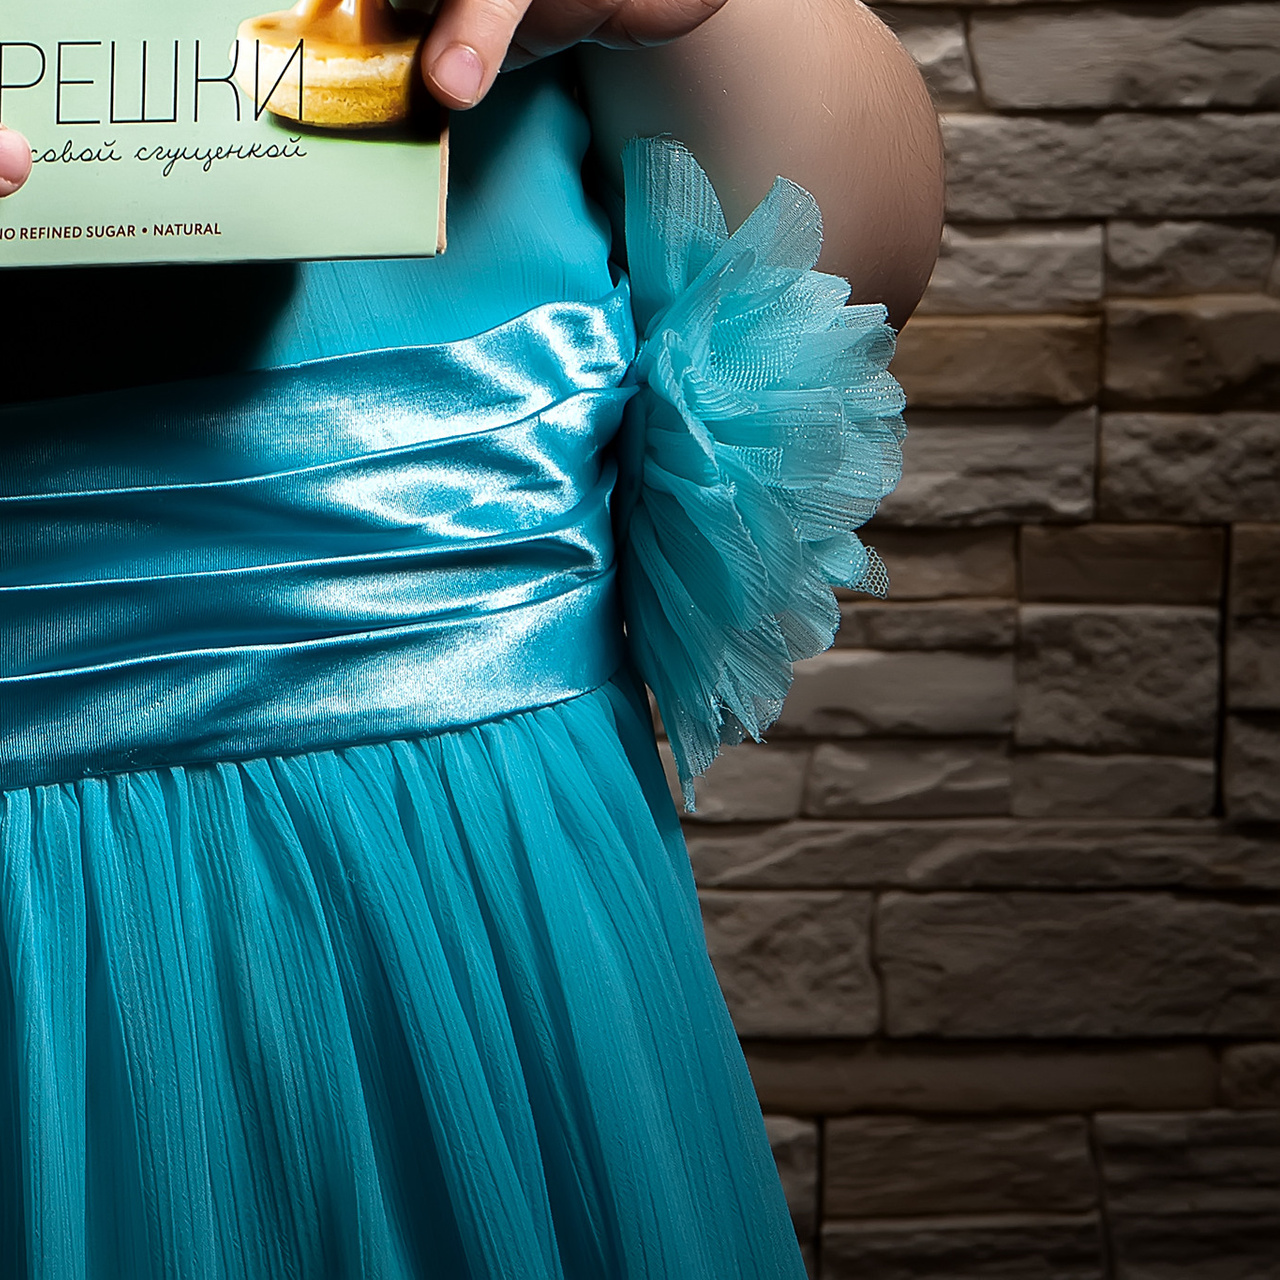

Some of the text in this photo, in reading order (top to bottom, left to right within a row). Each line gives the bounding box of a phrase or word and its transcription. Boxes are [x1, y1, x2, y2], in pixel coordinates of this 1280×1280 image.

[134, 135, 308, 177] сгущенкой
[19, 226, 83, 240] REFINED
[86, 225, 136, 238] SUGAR
[153, 222, 222, 236] NATURAL
